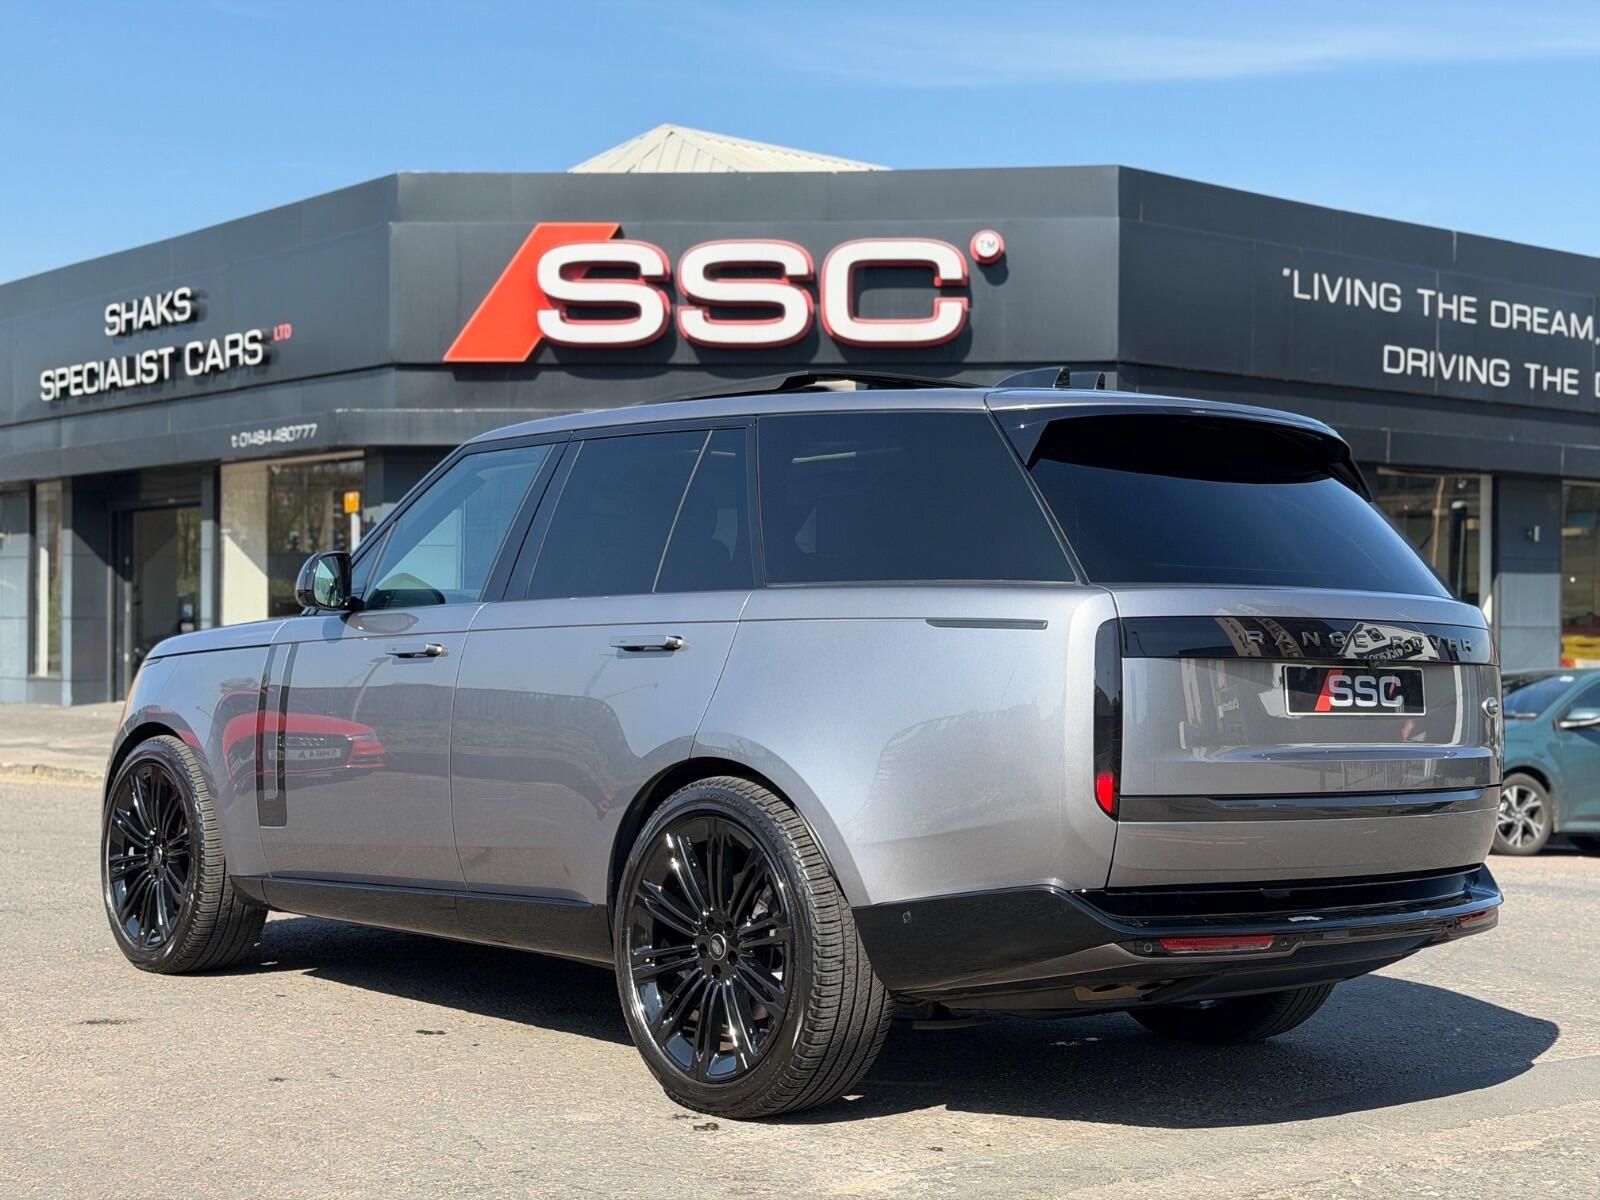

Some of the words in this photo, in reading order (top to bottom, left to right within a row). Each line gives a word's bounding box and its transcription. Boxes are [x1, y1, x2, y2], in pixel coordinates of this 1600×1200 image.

[104, 286, 192, 336] SHAKS
[536, 238, 968, 348] SSC
[1416, 287, 1478, 324] THE
[40, 347, 175, 401] SPECIALIST
[184, 329, 263, 376] CARS
[273, 323, 292, 341] LTD
[1382, 344, 1510, 387] DRIVING
[1524, 362, 1579, 395] THE
[1245, 630, 1369, 649] RANGE
[1329, 675, 1404, 708] SSC
